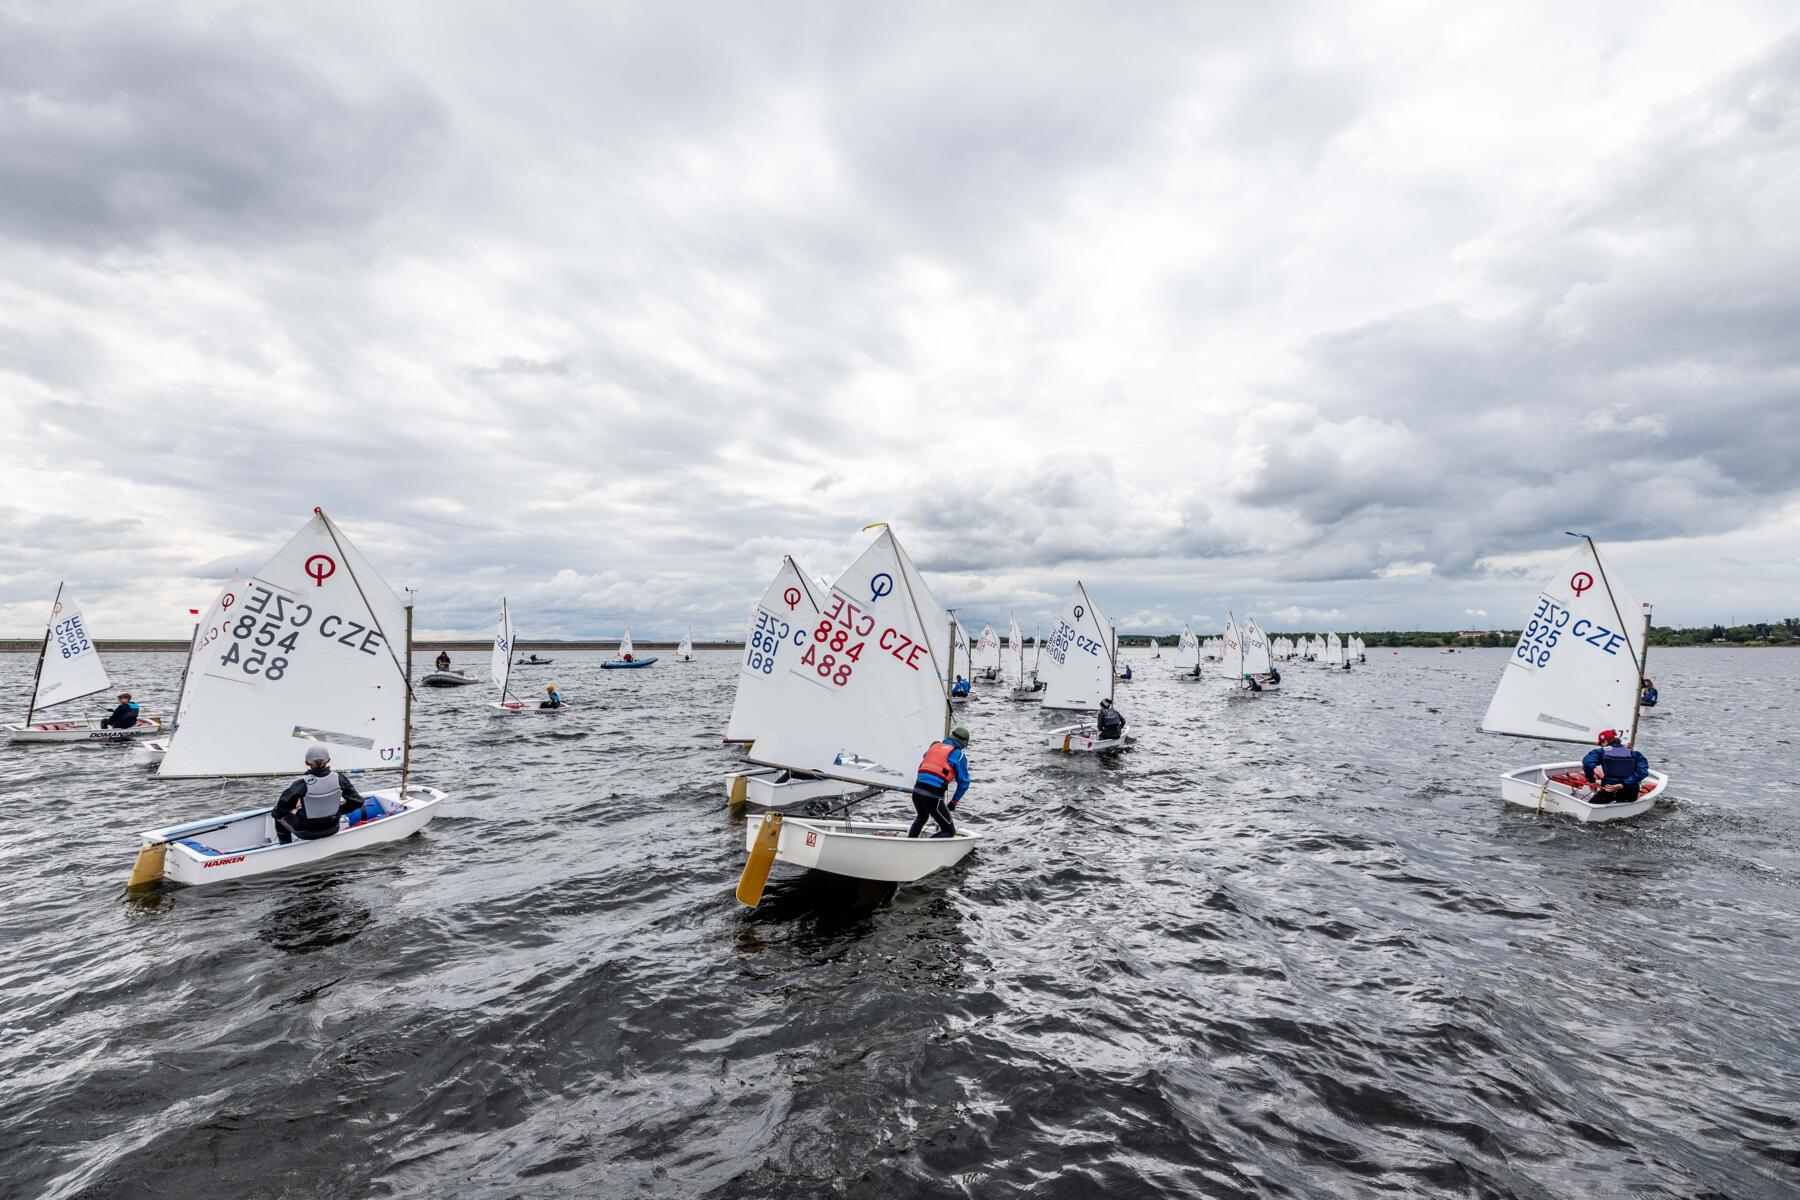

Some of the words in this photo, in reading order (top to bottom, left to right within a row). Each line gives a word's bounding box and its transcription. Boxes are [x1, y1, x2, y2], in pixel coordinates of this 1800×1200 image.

[55, 616, 82, 636] CZE
[233, 615, 299, 654] 854
[319, 615, 385, 656] CZE
[1525, 620, 1561, 648] 925
[1572, 619, 1625, 655] CZE
[62, 639, 91, 659] 852
[752, 630, 779, 656] 861
[814, 620, 865, 664] 884
[879, 628, 928, 671] CZE
[1056, 635, 1069, 652] 810
[1076, 635, 1102, 656] CZE
[203, 855, 245, 868] HARKEN
